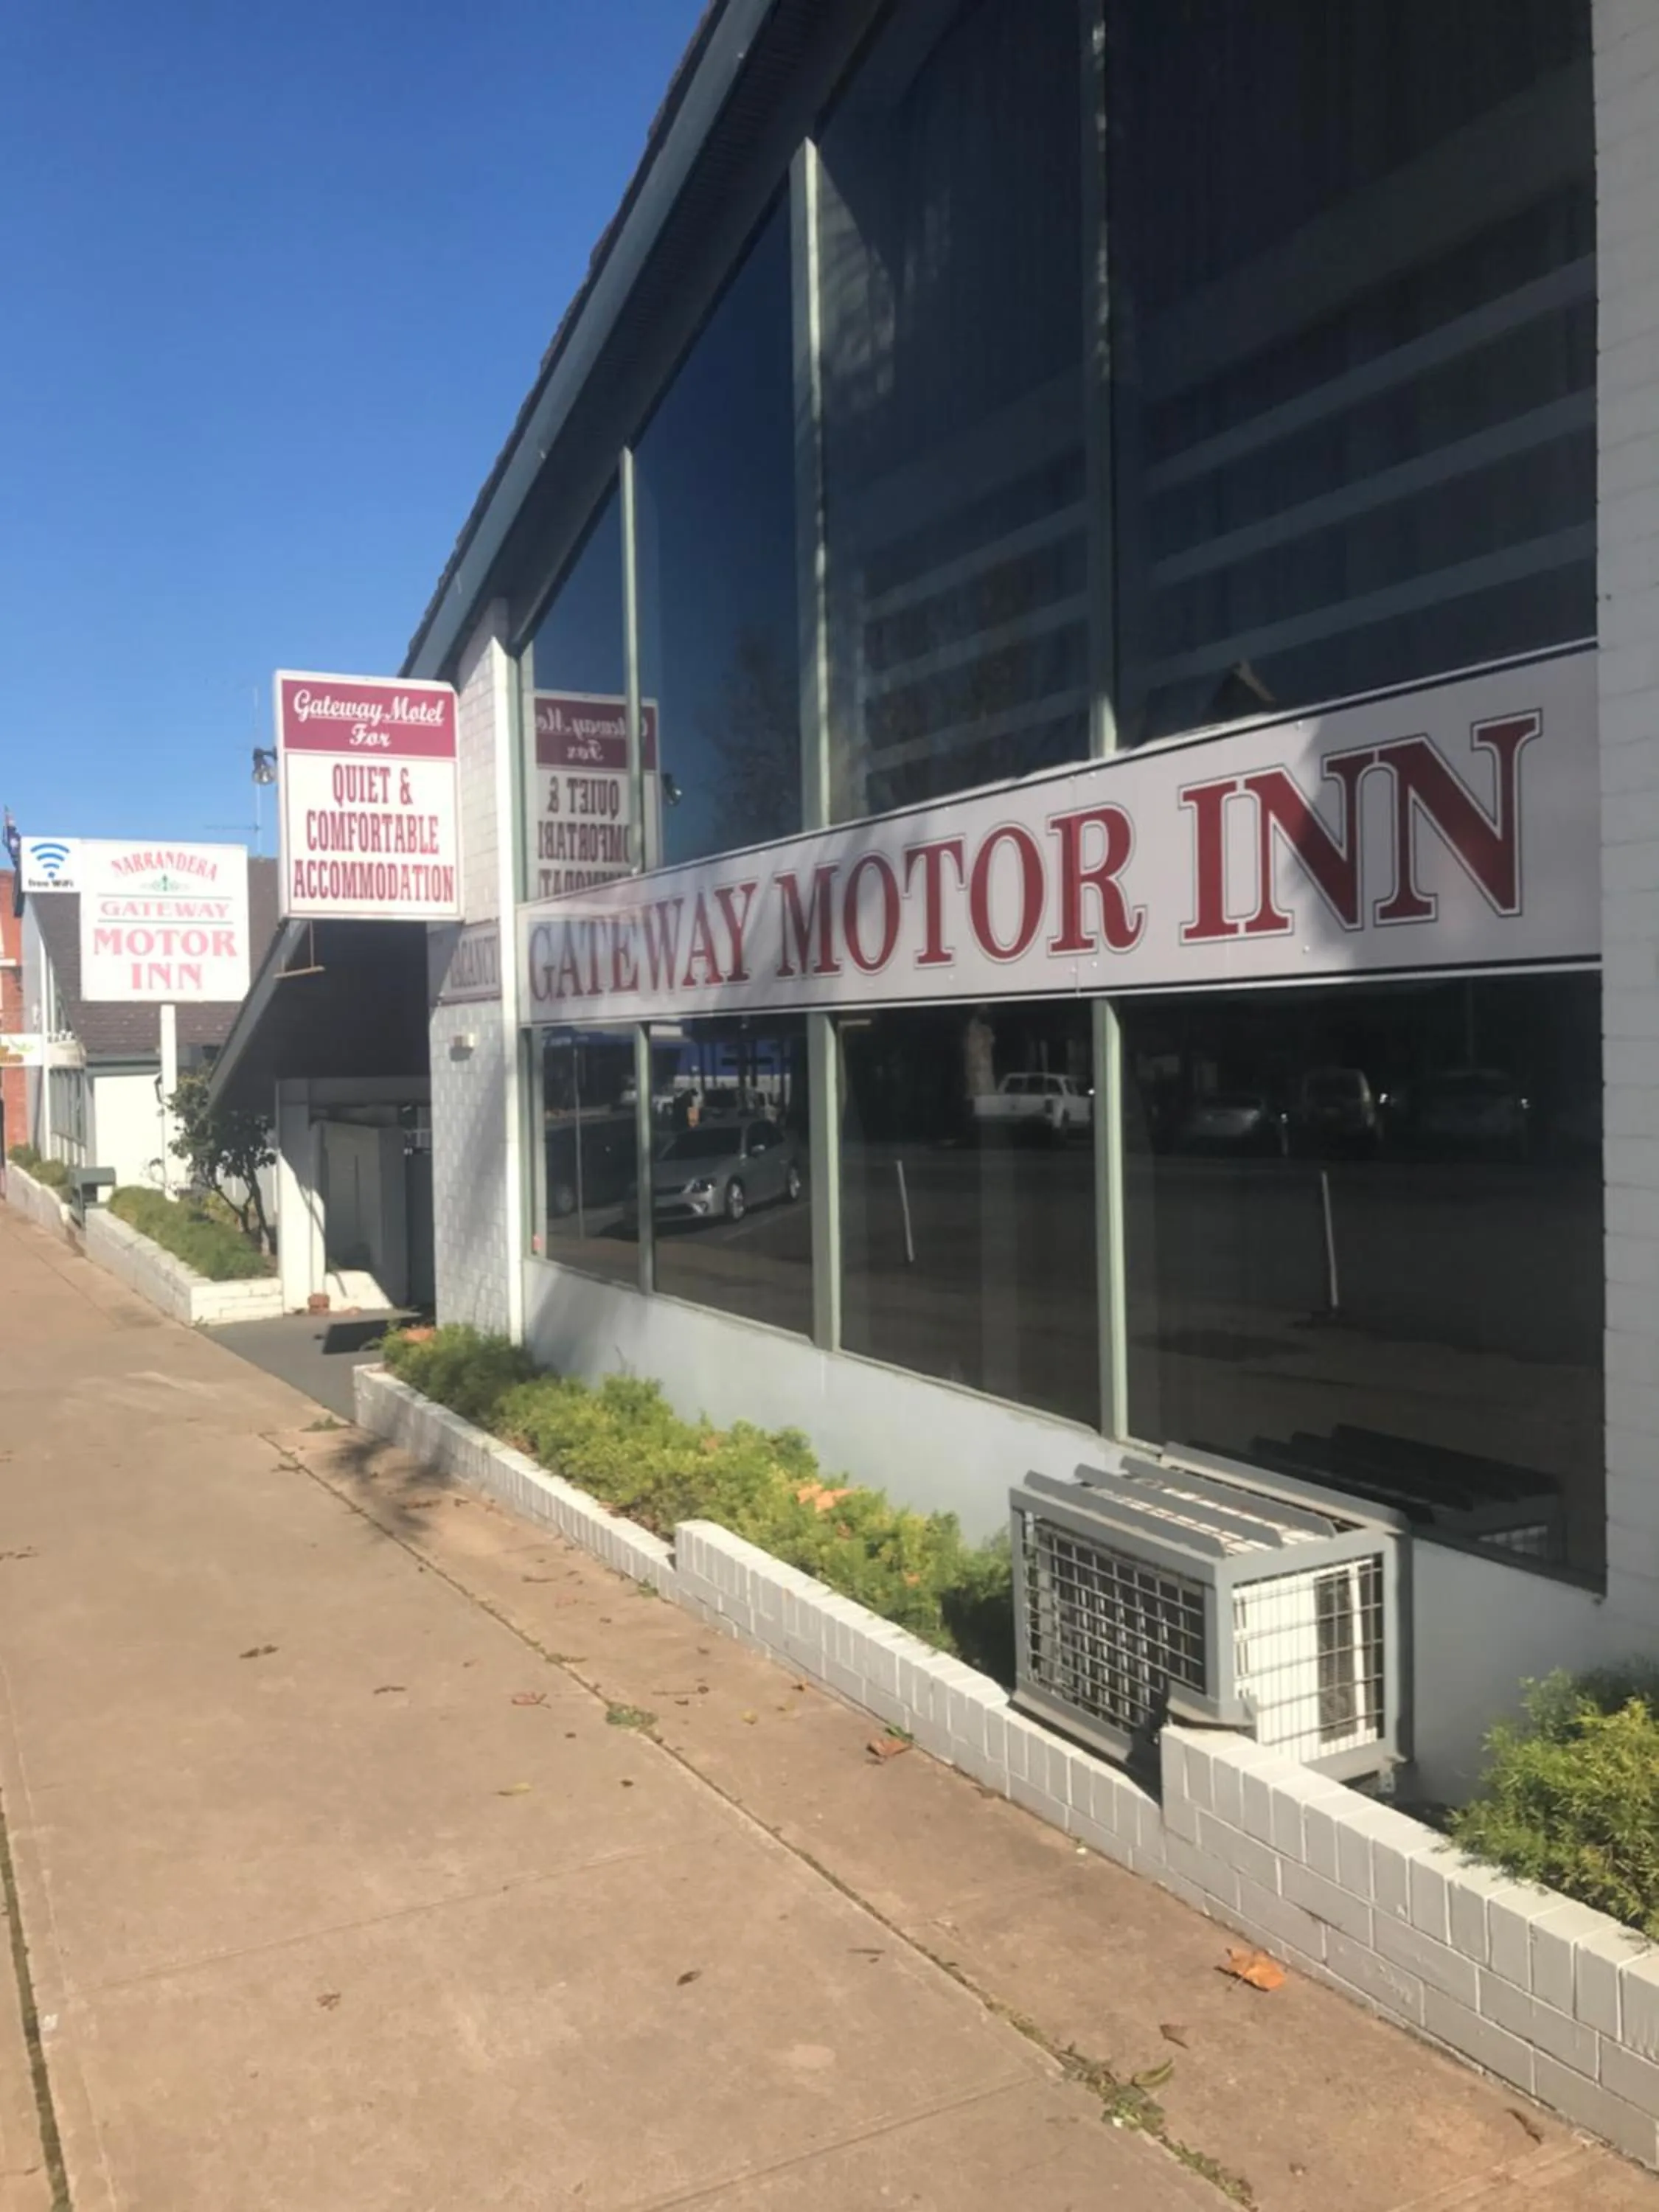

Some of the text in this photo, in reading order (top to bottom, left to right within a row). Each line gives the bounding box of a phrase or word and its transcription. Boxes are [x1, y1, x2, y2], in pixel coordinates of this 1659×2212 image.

[293, 689, 445, 726] Gateway Motel
[349, 723, 391, 746] For
[333, 764, 413, 807] QUIET &
[307, 809, 439, 855] COMFORTABLE
[111, 850, 218, 882] NARRANDERA
[529, 709, 1542, 1001] GATEWAY MOTOR INN
[293, 860, 454, 902] ACCOMMODATION
[100, 901, 230, 919] GATEWAY
[93, 928, 237, 957] MOTOR
[131, 962, 203, 990] INN
